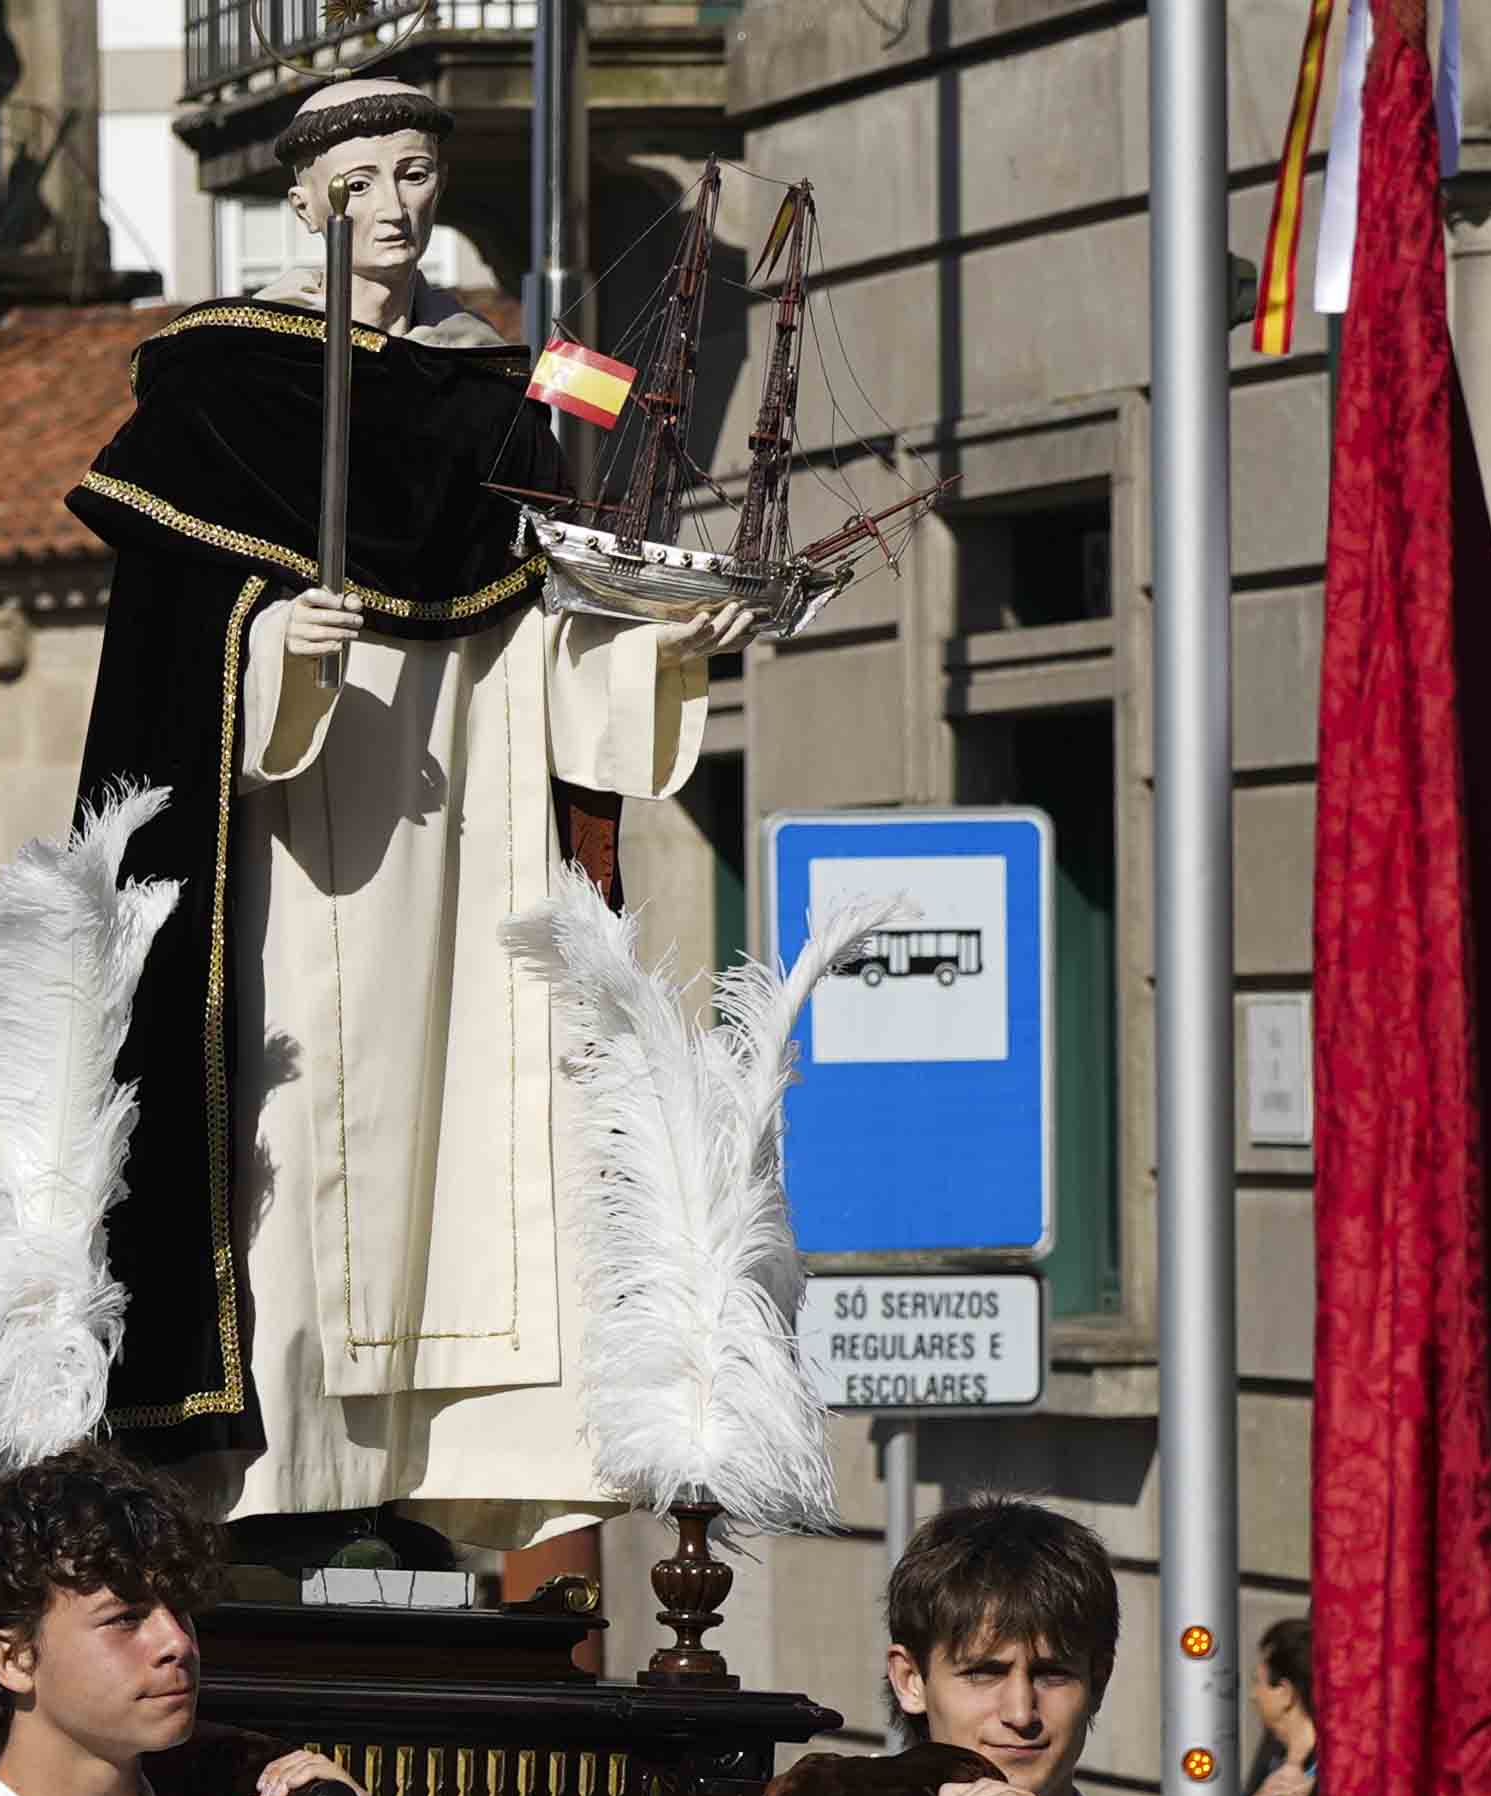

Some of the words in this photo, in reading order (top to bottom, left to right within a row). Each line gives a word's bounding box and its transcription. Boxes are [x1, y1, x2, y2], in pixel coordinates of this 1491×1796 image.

[835, 1286, 867, 1320] SÓ
[881, 1291, 1000, 1320] SERVIZOS
[830, 1333, 976, 1361] REGULARES
[989, 1332, 1003, 1360] E
[845, 1374, 988, 1403] ESCOLARES
